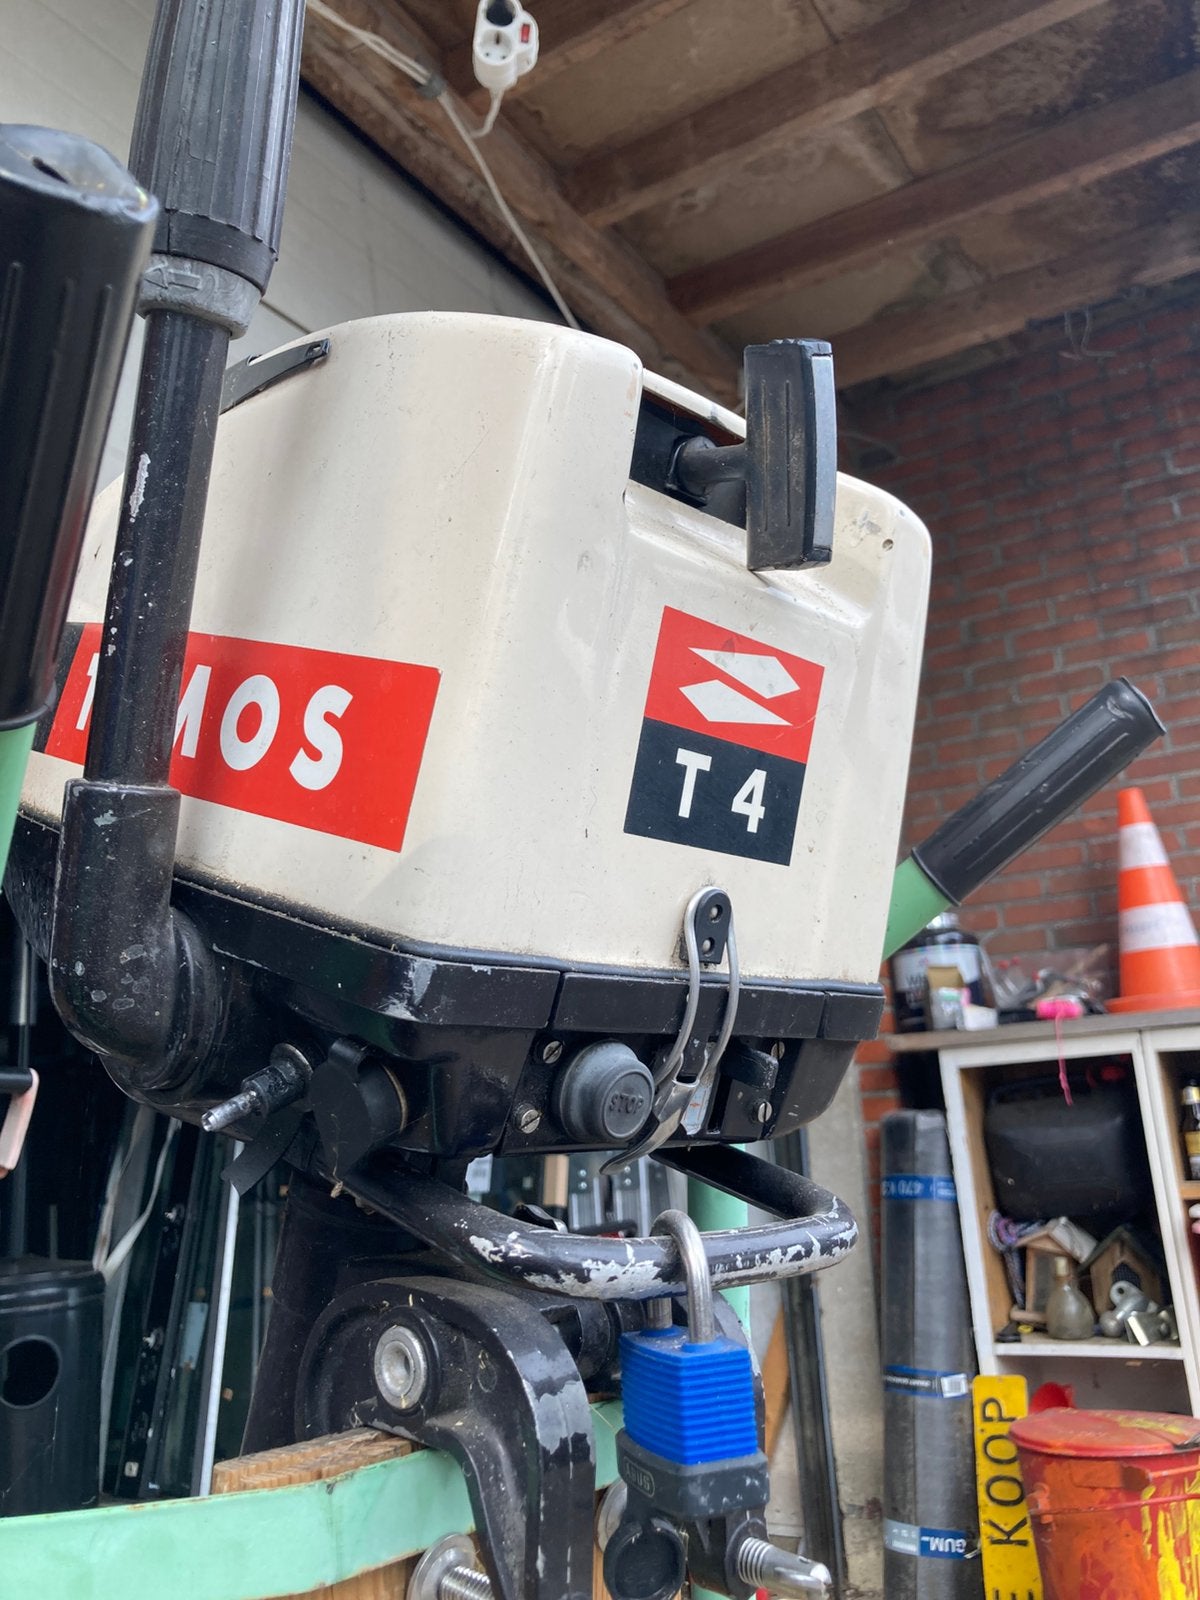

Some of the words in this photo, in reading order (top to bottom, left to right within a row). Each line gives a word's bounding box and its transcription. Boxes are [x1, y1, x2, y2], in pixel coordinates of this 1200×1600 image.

[675, 747, 712, 819] T
[731, 768, 767, 833] 4
[608, 1093, 645, 1114] STOP
[981, 1397, 1029, 1547] KOOP
